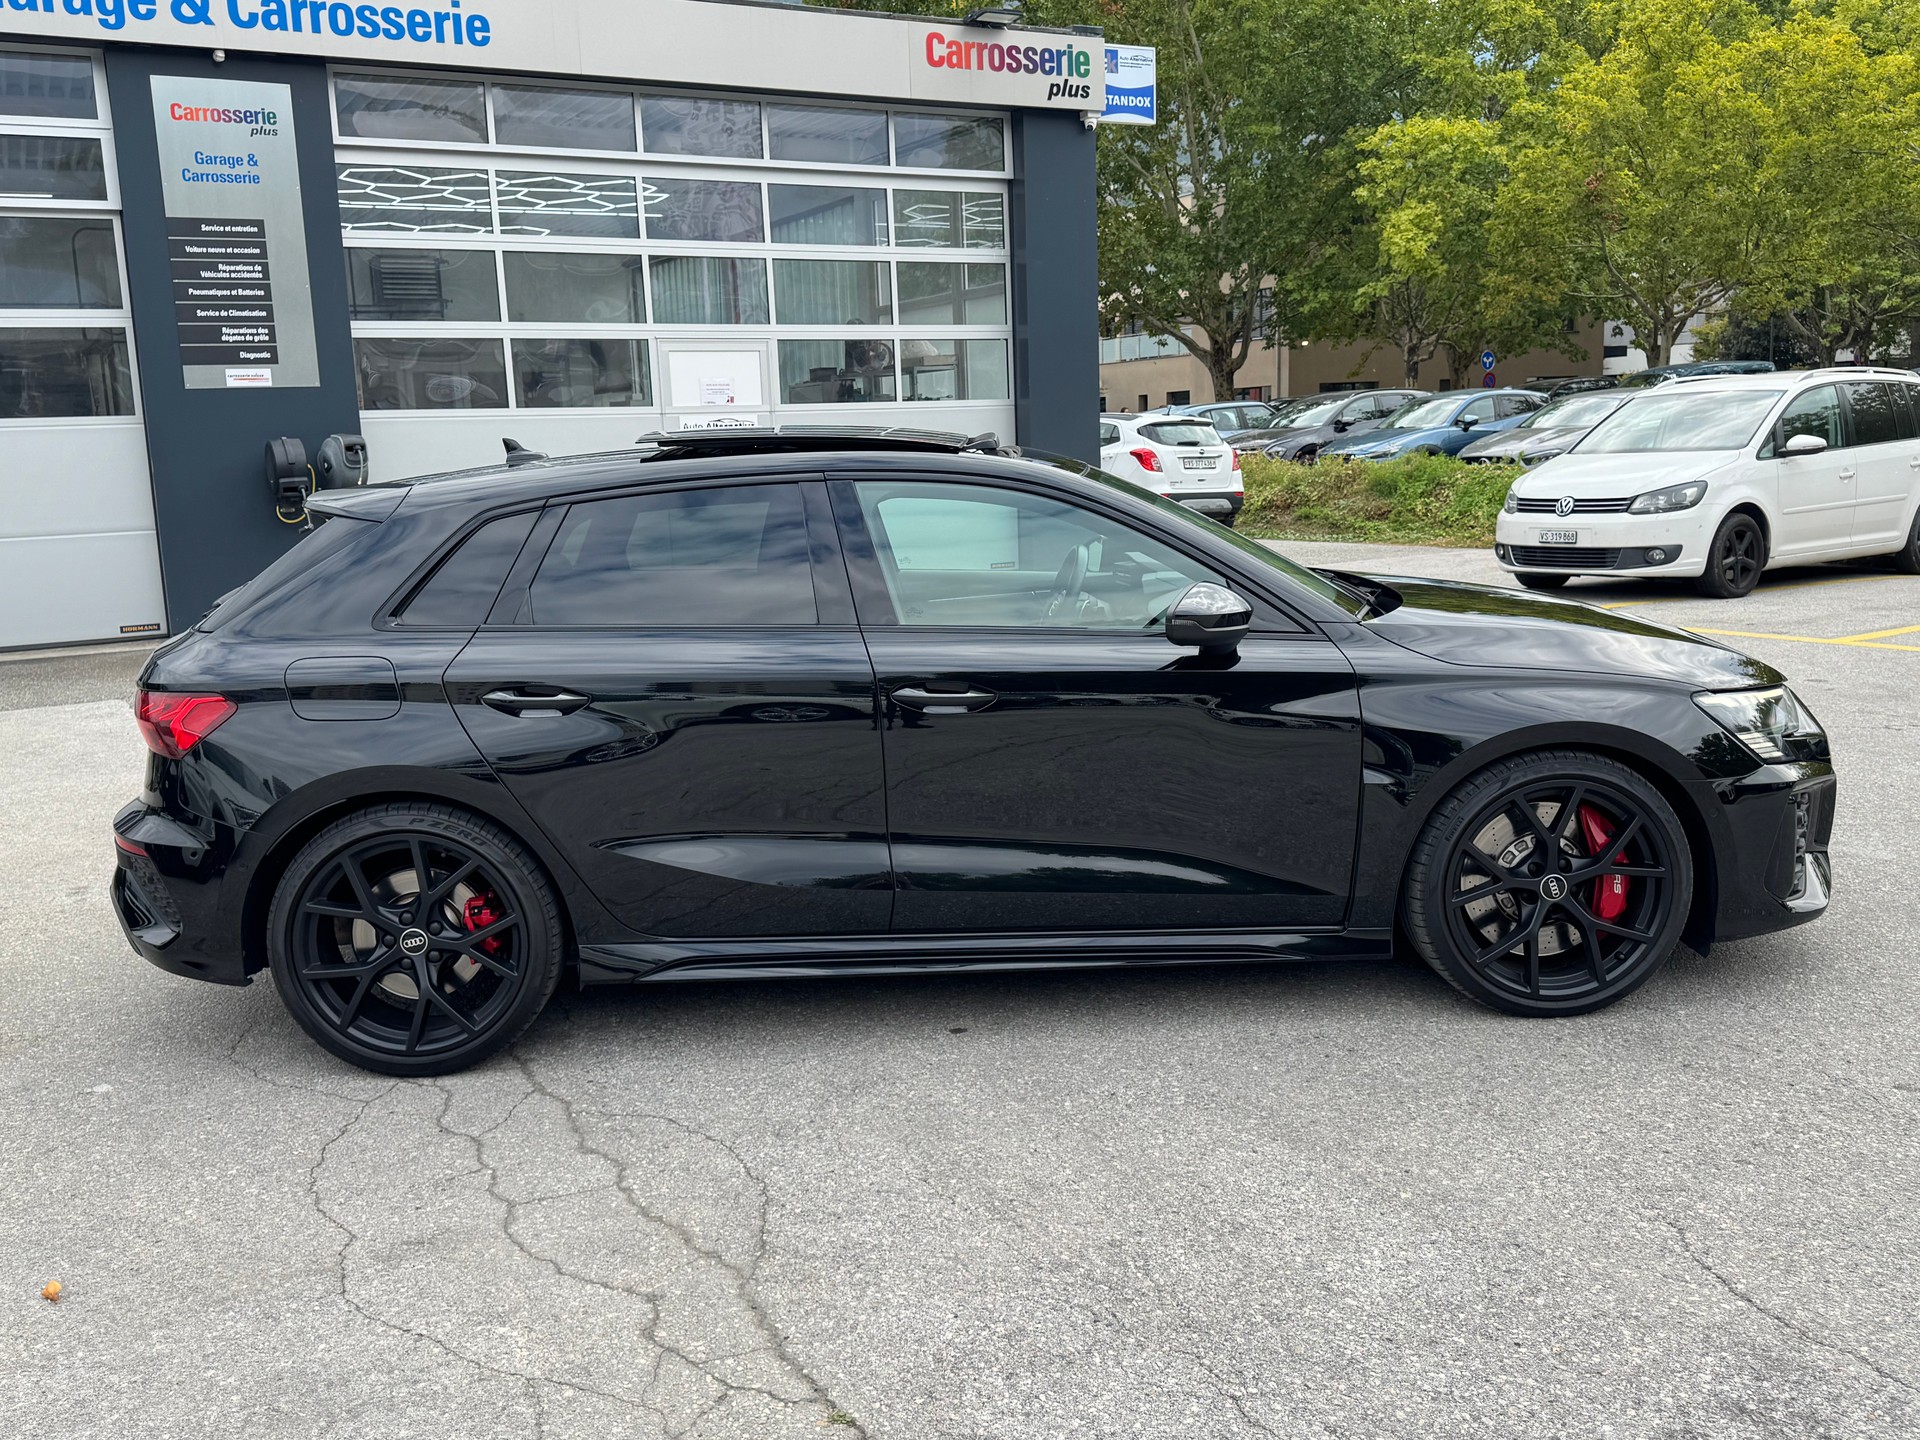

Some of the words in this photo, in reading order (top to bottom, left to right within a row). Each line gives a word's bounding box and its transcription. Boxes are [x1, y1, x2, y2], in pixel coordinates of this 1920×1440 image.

[171, 0, 215, 26] &
[227, 0, 491, 47] Carrosserie
[925, 31, 1091, 79] Carrosserie
[1047, 79, 1091, 101] plus
[170, 102, 278, 126] Carrosserie
[250, 125, 278, 137] plus
[194, 150, 244, 169] Garage
[247, 153, 258, 167] &
[181, 168, 260, 184] Carrosserie
[201, 223, 224, 232] Service
[225, 224, 231, 232] et
[232, 224, 258, 232] entretien
[185, 245, 207, 253] Voiture
[218, 263, 253, 272] Réparations
[200, 270, 230, 278] Véhicules
[188, 288, 230, 297] Pneumatiques
[238, 288, 265, 296] Batteries
[196, 309, 220, 317] Service
[228, 309, 267, 317] Climatisation
[221, 327, 257, 335] Réparations
[239, 351, 271, 360] Diagnostic
[408, 817, 424, 825] P
[427, 820, 487, 847] ZERO
[1614, 874, 1622, 894] RS
